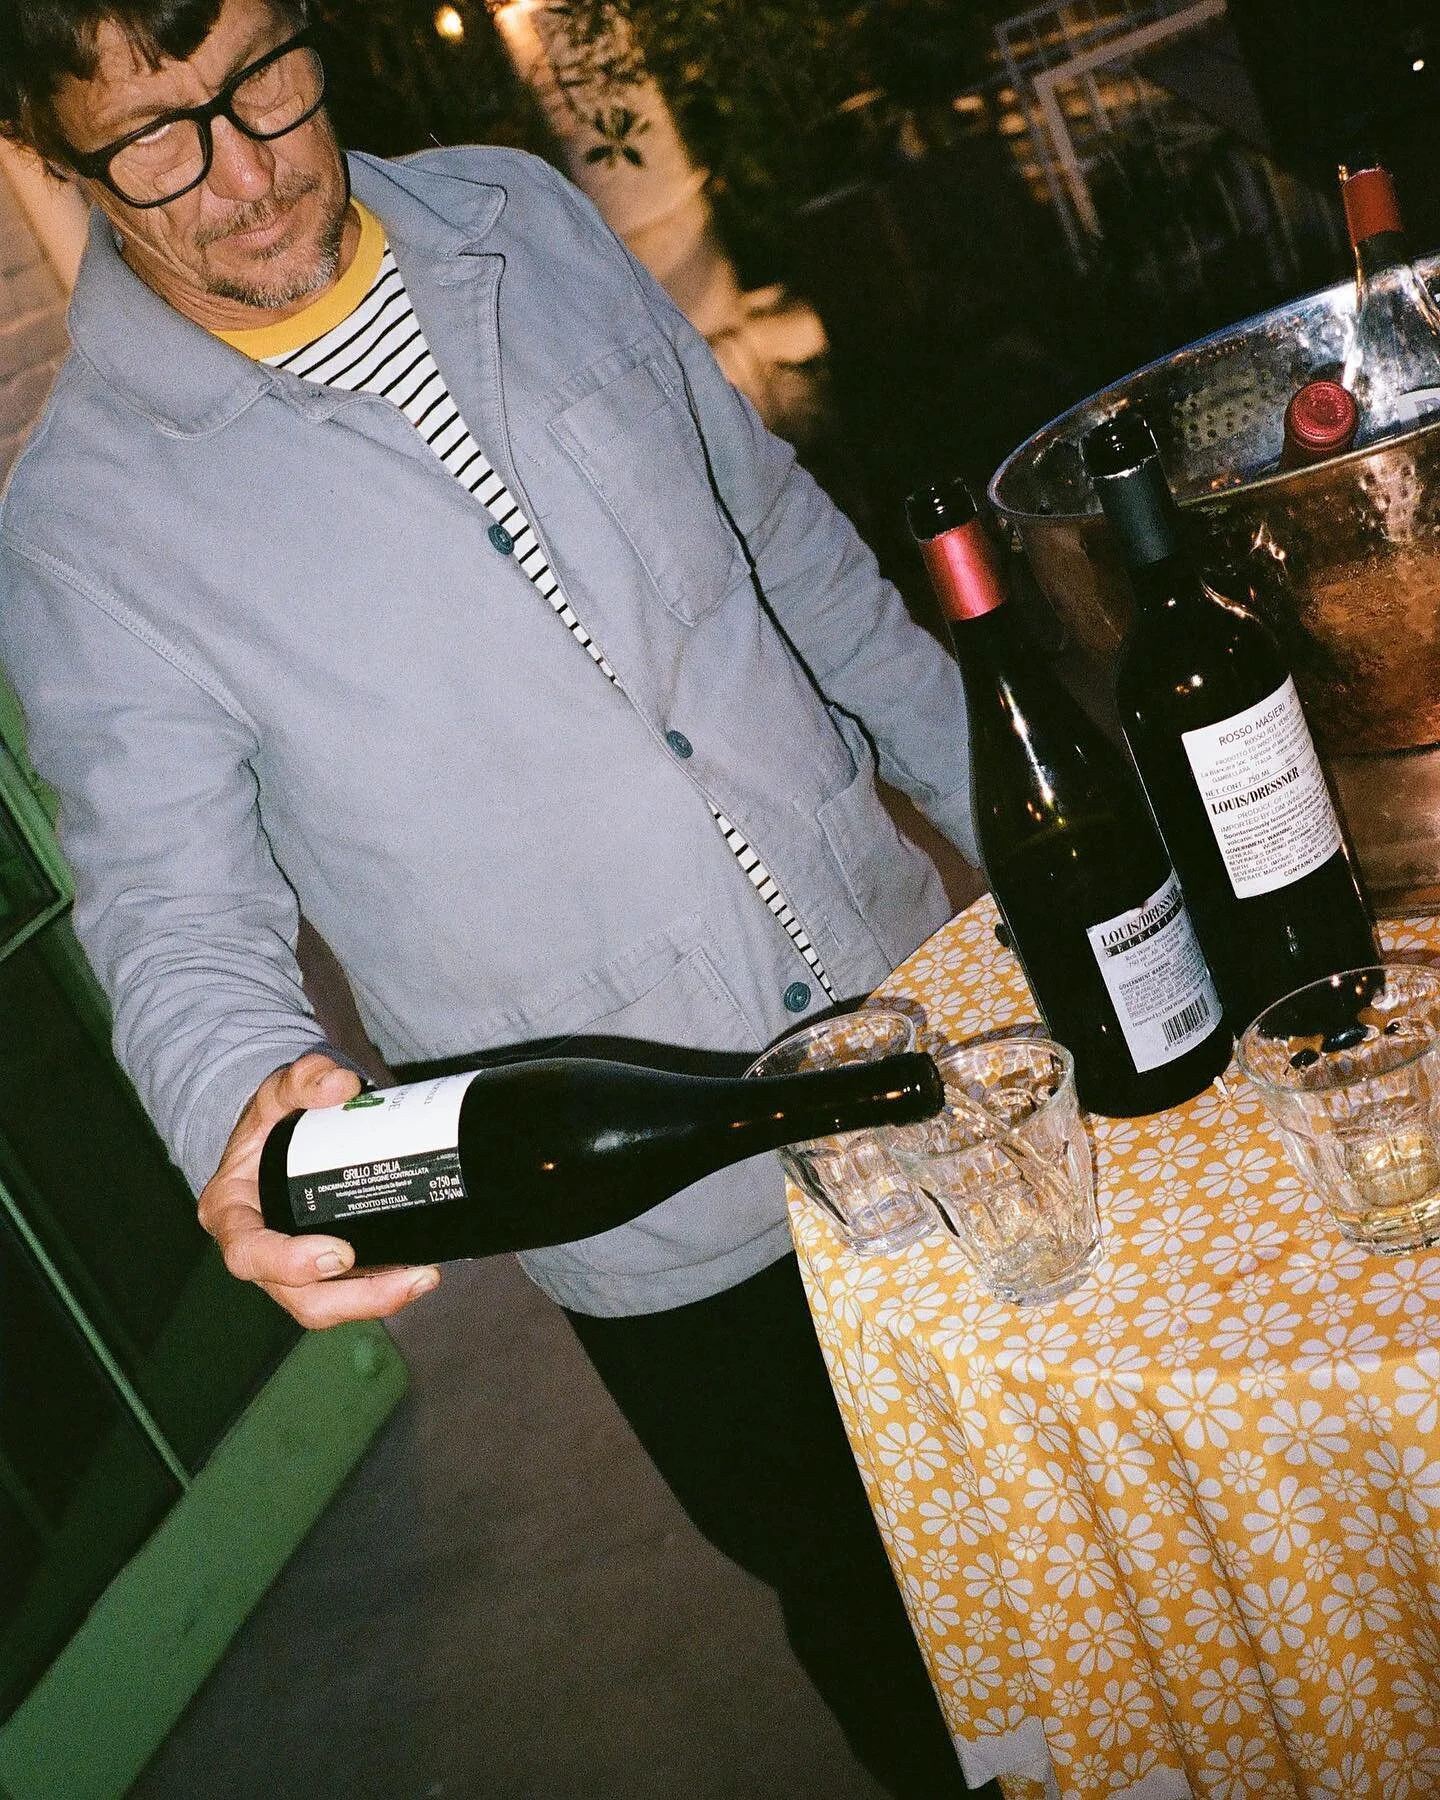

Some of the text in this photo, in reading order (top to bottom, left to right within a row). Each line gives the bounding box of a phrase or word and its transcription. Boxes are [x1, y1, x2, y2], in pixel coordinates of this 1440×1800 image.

[1218, 726, 1252, 746] ROSSO
[1255, 704, 1285, 728] MASIERI
[1244, 732, 1265, 746] ROSSO
[1211, 766, 1300, 815] LOUIS/DRESSNER
[1237, 804, 1270, 819] PRODUCE
[1221, 817, 1258, 832] IMPORTED
[1224, 822, 1268, 839] Spontaneously
[1226, 840, 1264, 854] GOVERNMENT
[1284, 860, 1313, 877] CONTAINS
[1314, 852, 1322, 860] NO
[1119, 974, 1150, 990] GOVERNMENT
[343, 1161, 399, 1180] GRILLO SICILIA
[318, 1180, 359, 1192] DENOMINAZIONE
[367, 1174, 388, 1182] ORIGINE
[389, 1167, 428, 1179] CONTROLLATA
[450, 1175, 459, 1184] ml
[304, 1187, 316, 1211] 2019
[348, 1200, 379, 1209] PRODOTTO
[389, 1195, 407, 1203] ITALIA
